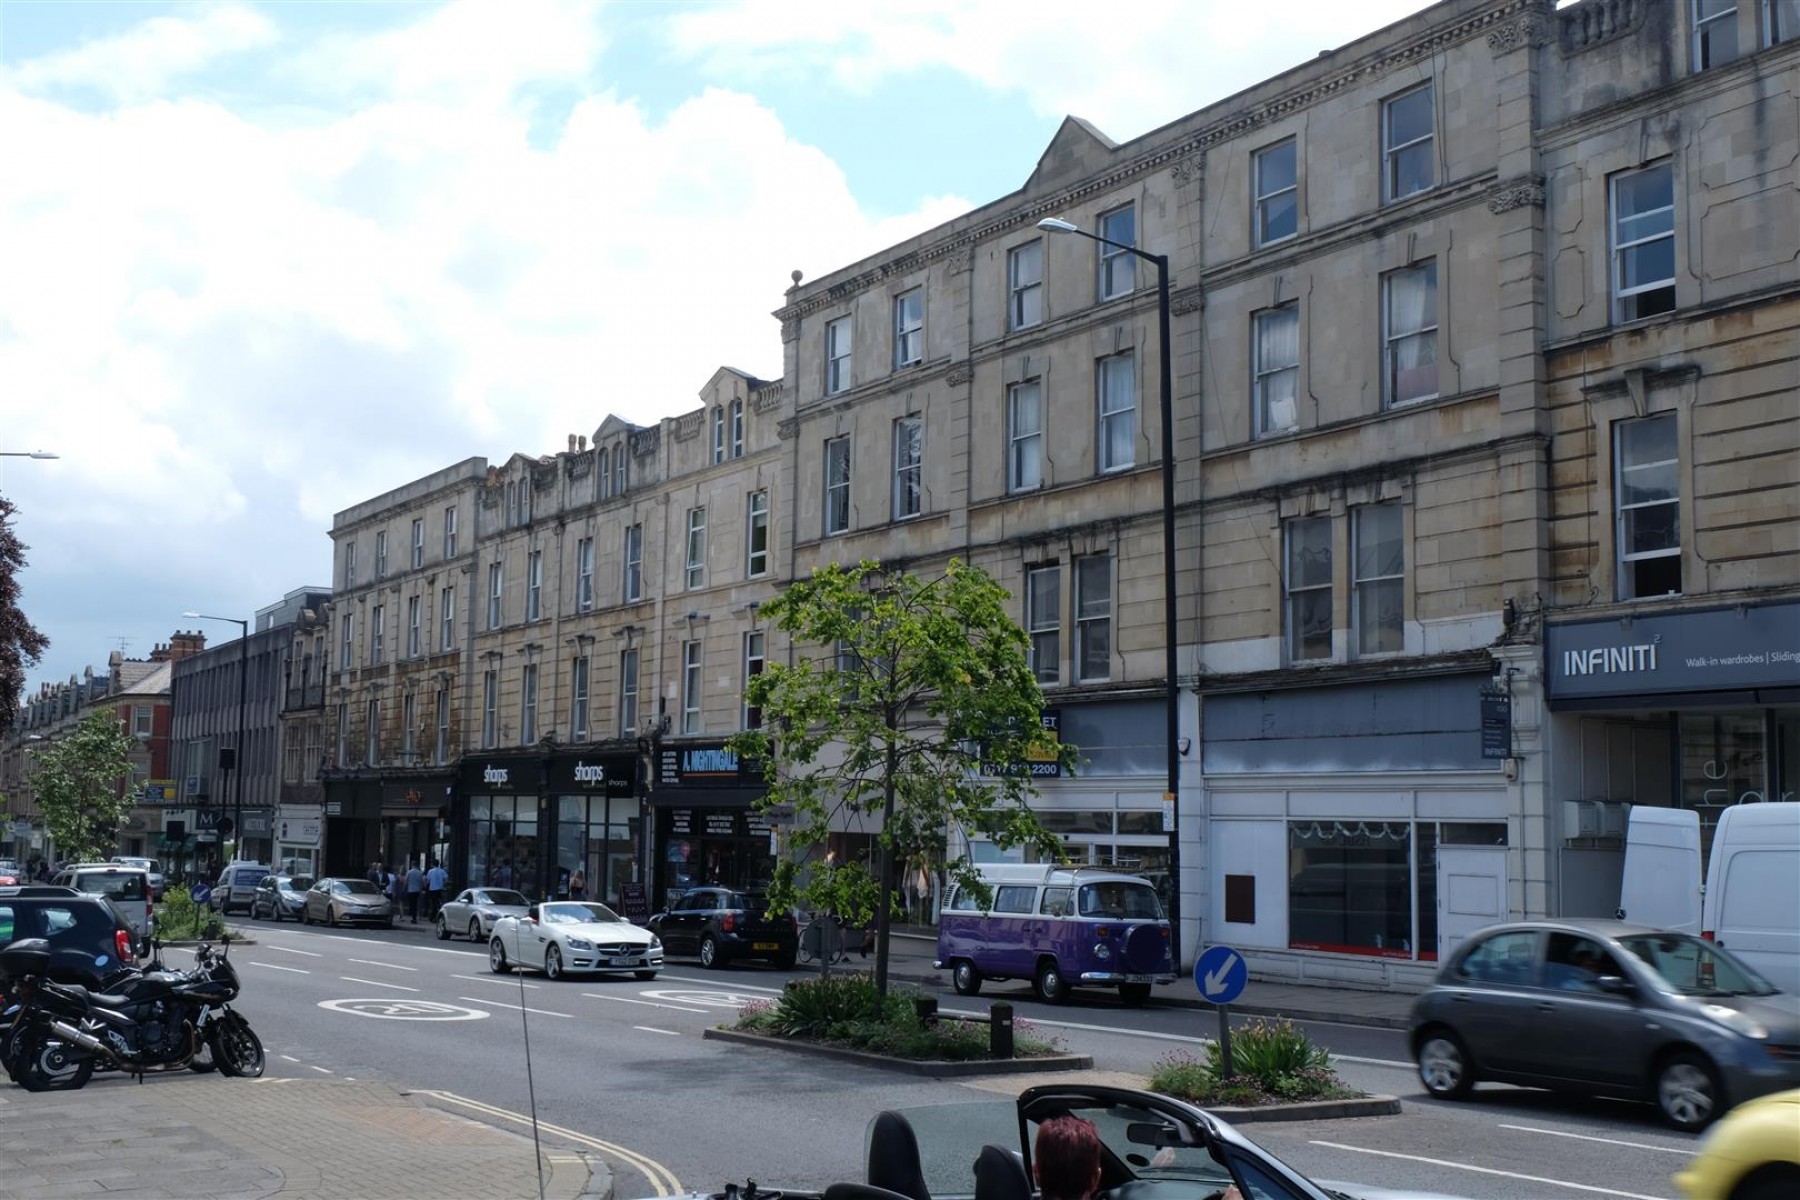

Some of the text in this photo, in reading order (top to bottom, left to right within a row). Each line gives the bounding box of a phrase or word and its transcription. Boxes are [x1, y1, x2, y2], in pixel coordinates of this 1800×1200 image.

[1564, 644, 1657, 676] INFINITI
[1686, 656, 1719, 668] Walk-in
[1720, 653, 1764, 666] wardrobes
[691, 749, 739, 772] NIGHTINGALE
[1032, 764, 1057, 774] 2200
[484, 764, 508, 788] sharps
[574, 760, 604, 787] sharps
[608, 778, 628, 787] sharps
